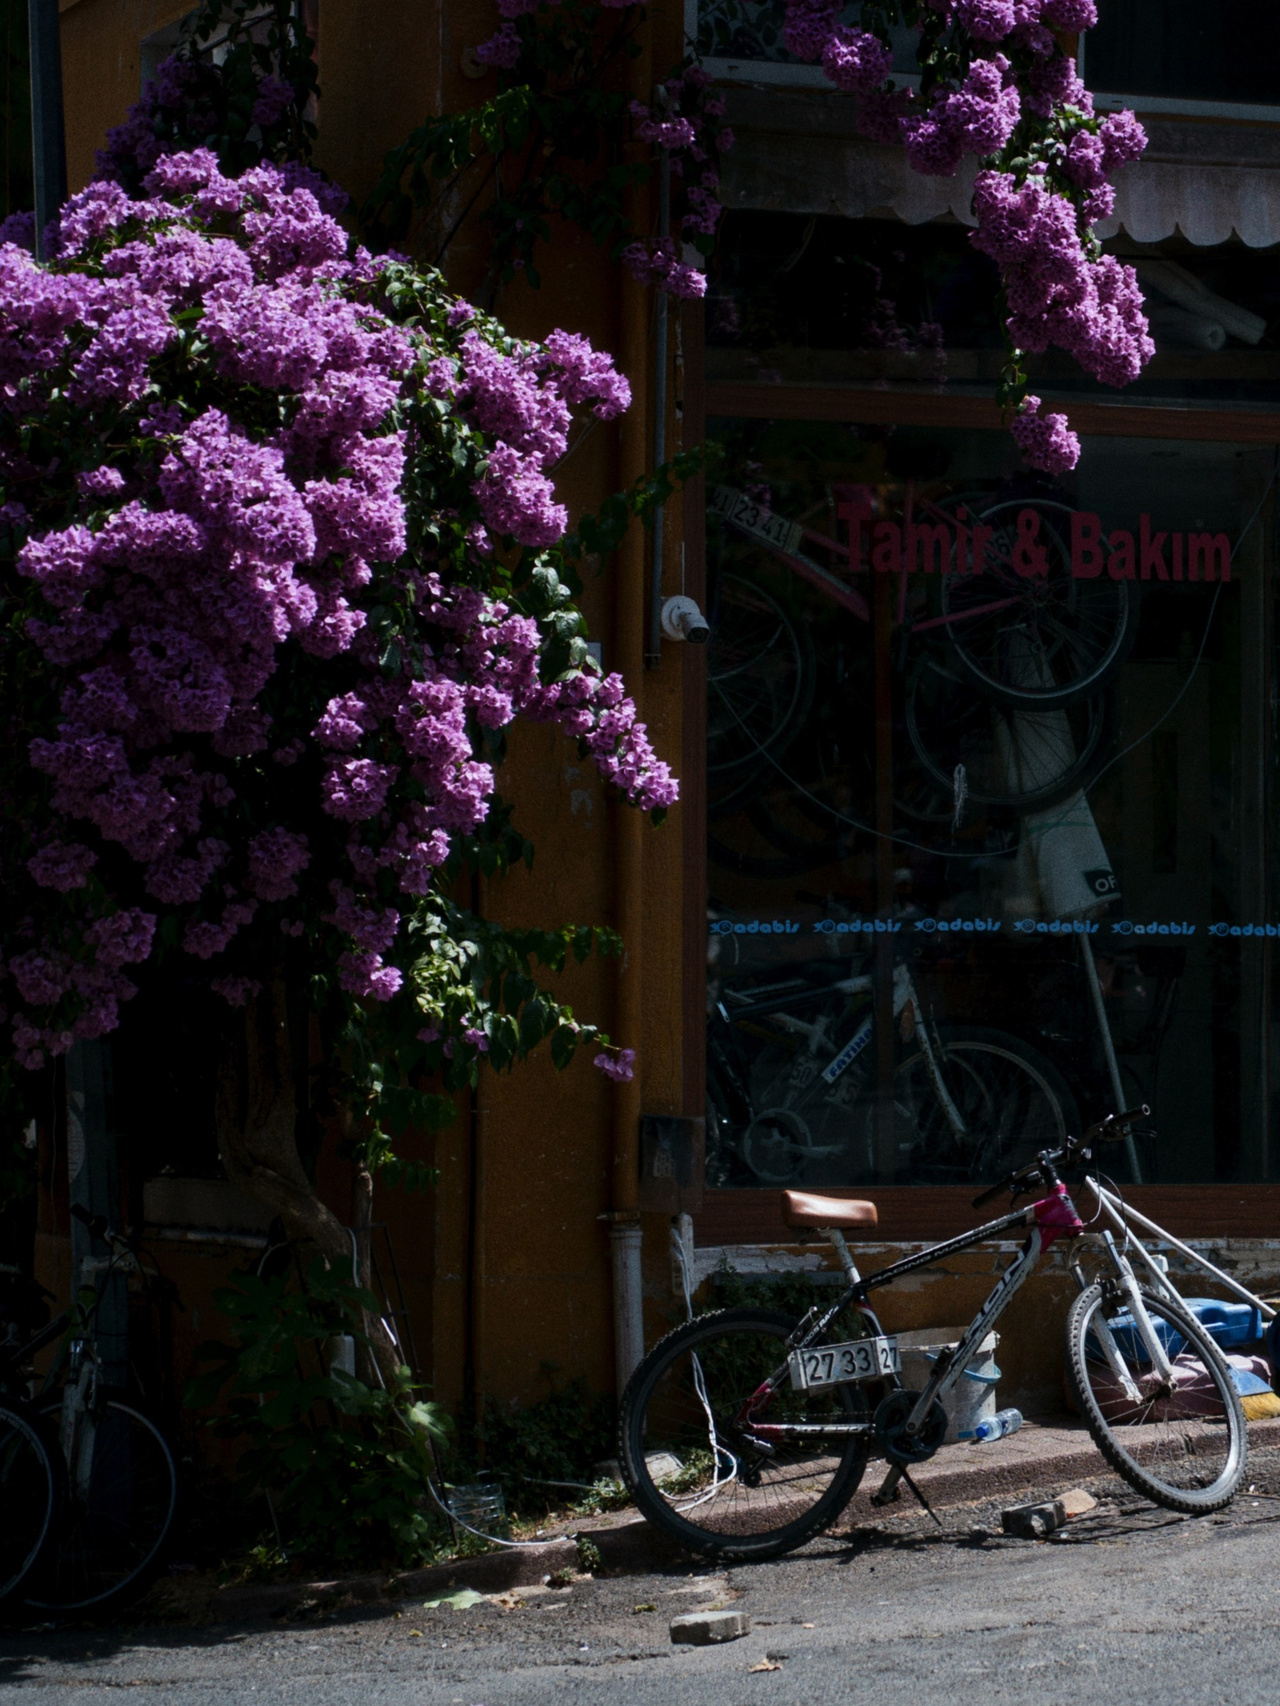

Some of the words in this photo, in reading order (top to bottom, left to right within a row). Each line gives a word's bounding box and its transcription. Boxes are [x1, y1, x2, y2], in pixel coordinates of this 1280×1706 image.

[836, 502, 993, 574] Tamir
[1011, 507, 1049, 578] &
[1070, 511, 1231, 582] Bakım
[870, 1255, 931, 1284] RACING
[933, 1223, 999, 1258] MACHINE
[807, 1354, 834, 1382] 27
[841, 1346, 871, 1375] 33
